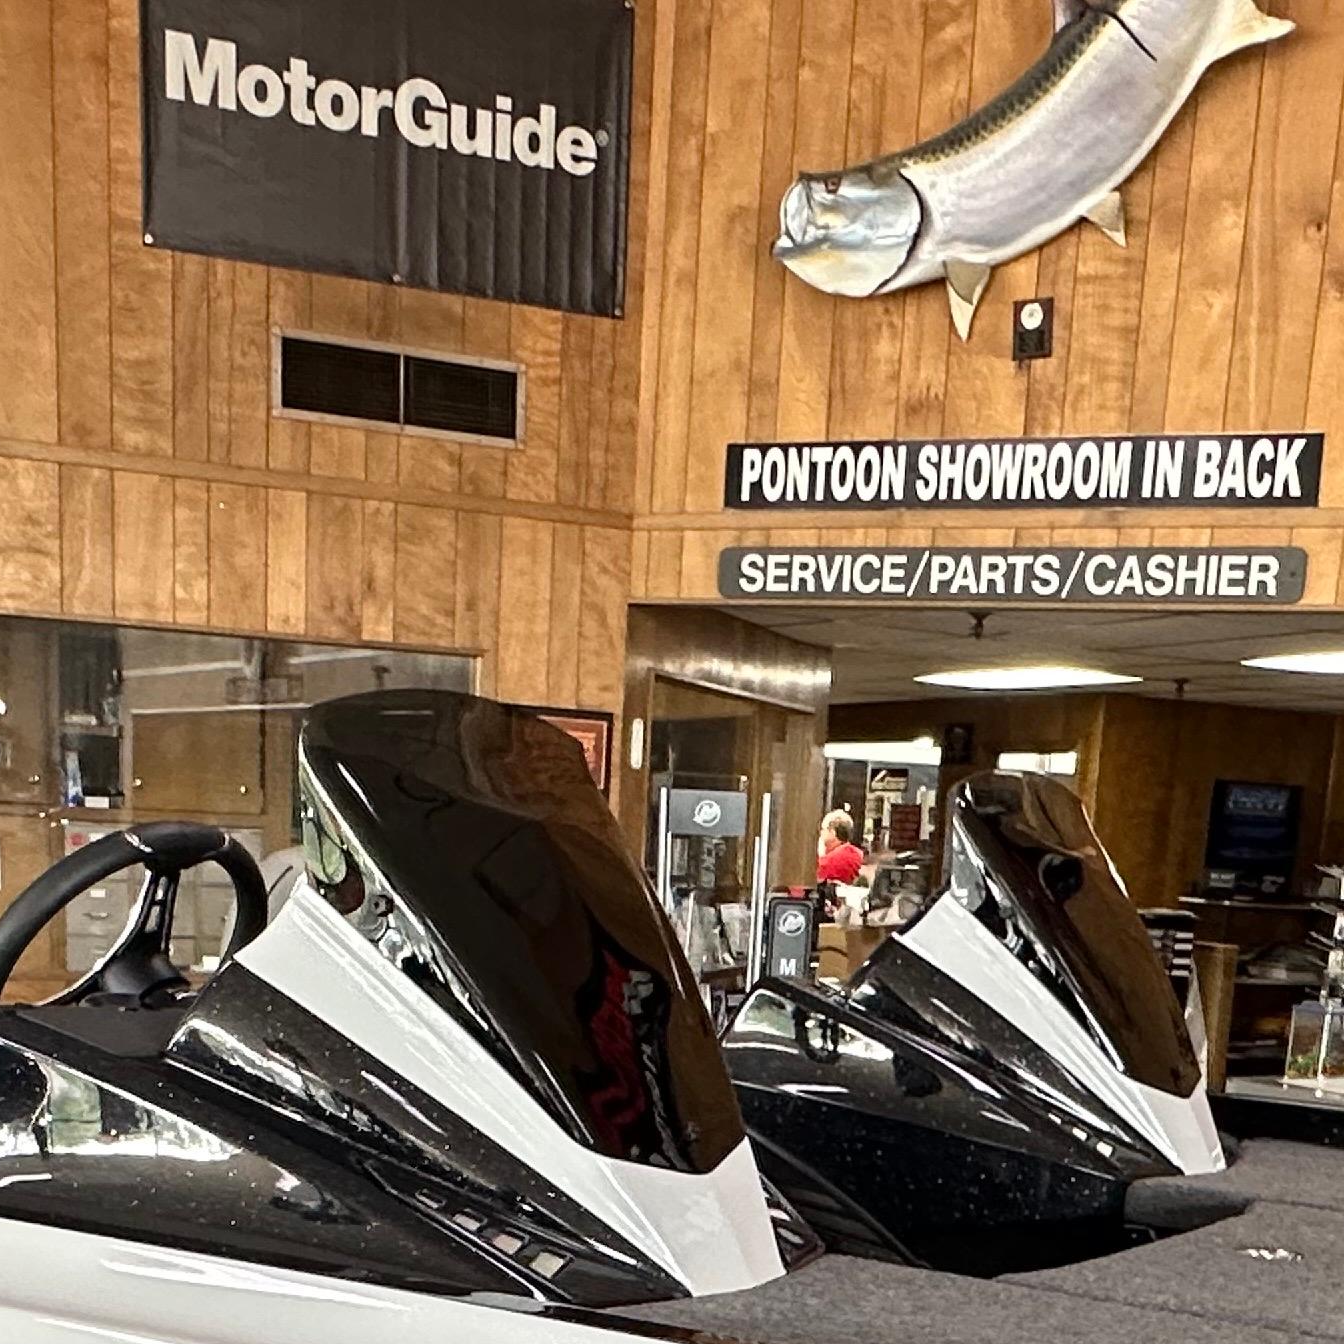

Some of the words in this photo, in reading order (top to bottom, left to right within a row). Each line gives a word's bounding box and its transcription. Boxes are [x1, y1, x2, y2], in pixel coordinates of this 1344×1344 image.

[739, 445, 907, 502] PONTOON
[914, 440, 1132, 501] SHOWROOM
[1140, 440, 1186, 499] IN
[1193, 438, 1307, 499] BACK
